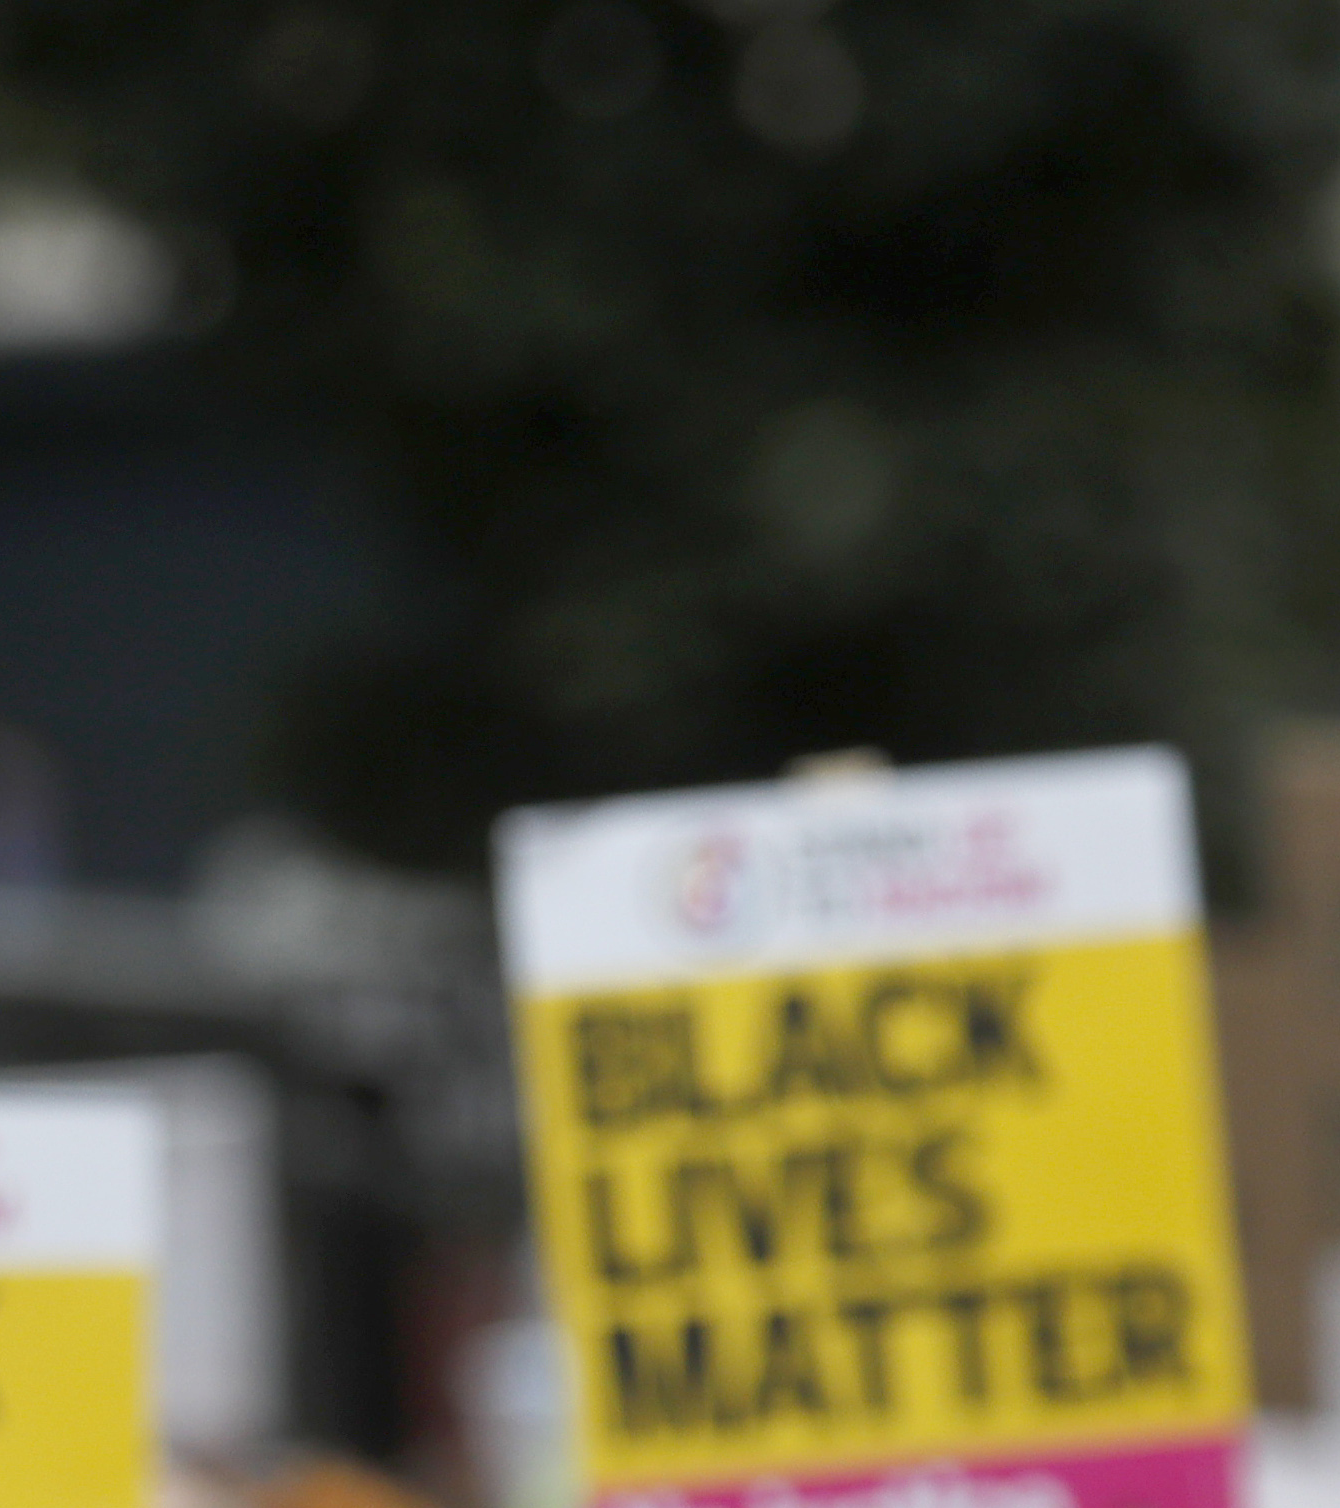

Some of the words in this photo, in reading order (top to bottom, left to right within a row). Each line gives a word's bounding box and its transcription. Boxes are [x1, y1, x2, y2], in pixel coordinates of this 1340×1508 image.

[570, 965, 1051, 1132] BLACK
[587, 1128, 999, 1290] LIVES
[607, 1262, 1195, 1444] MATTER
